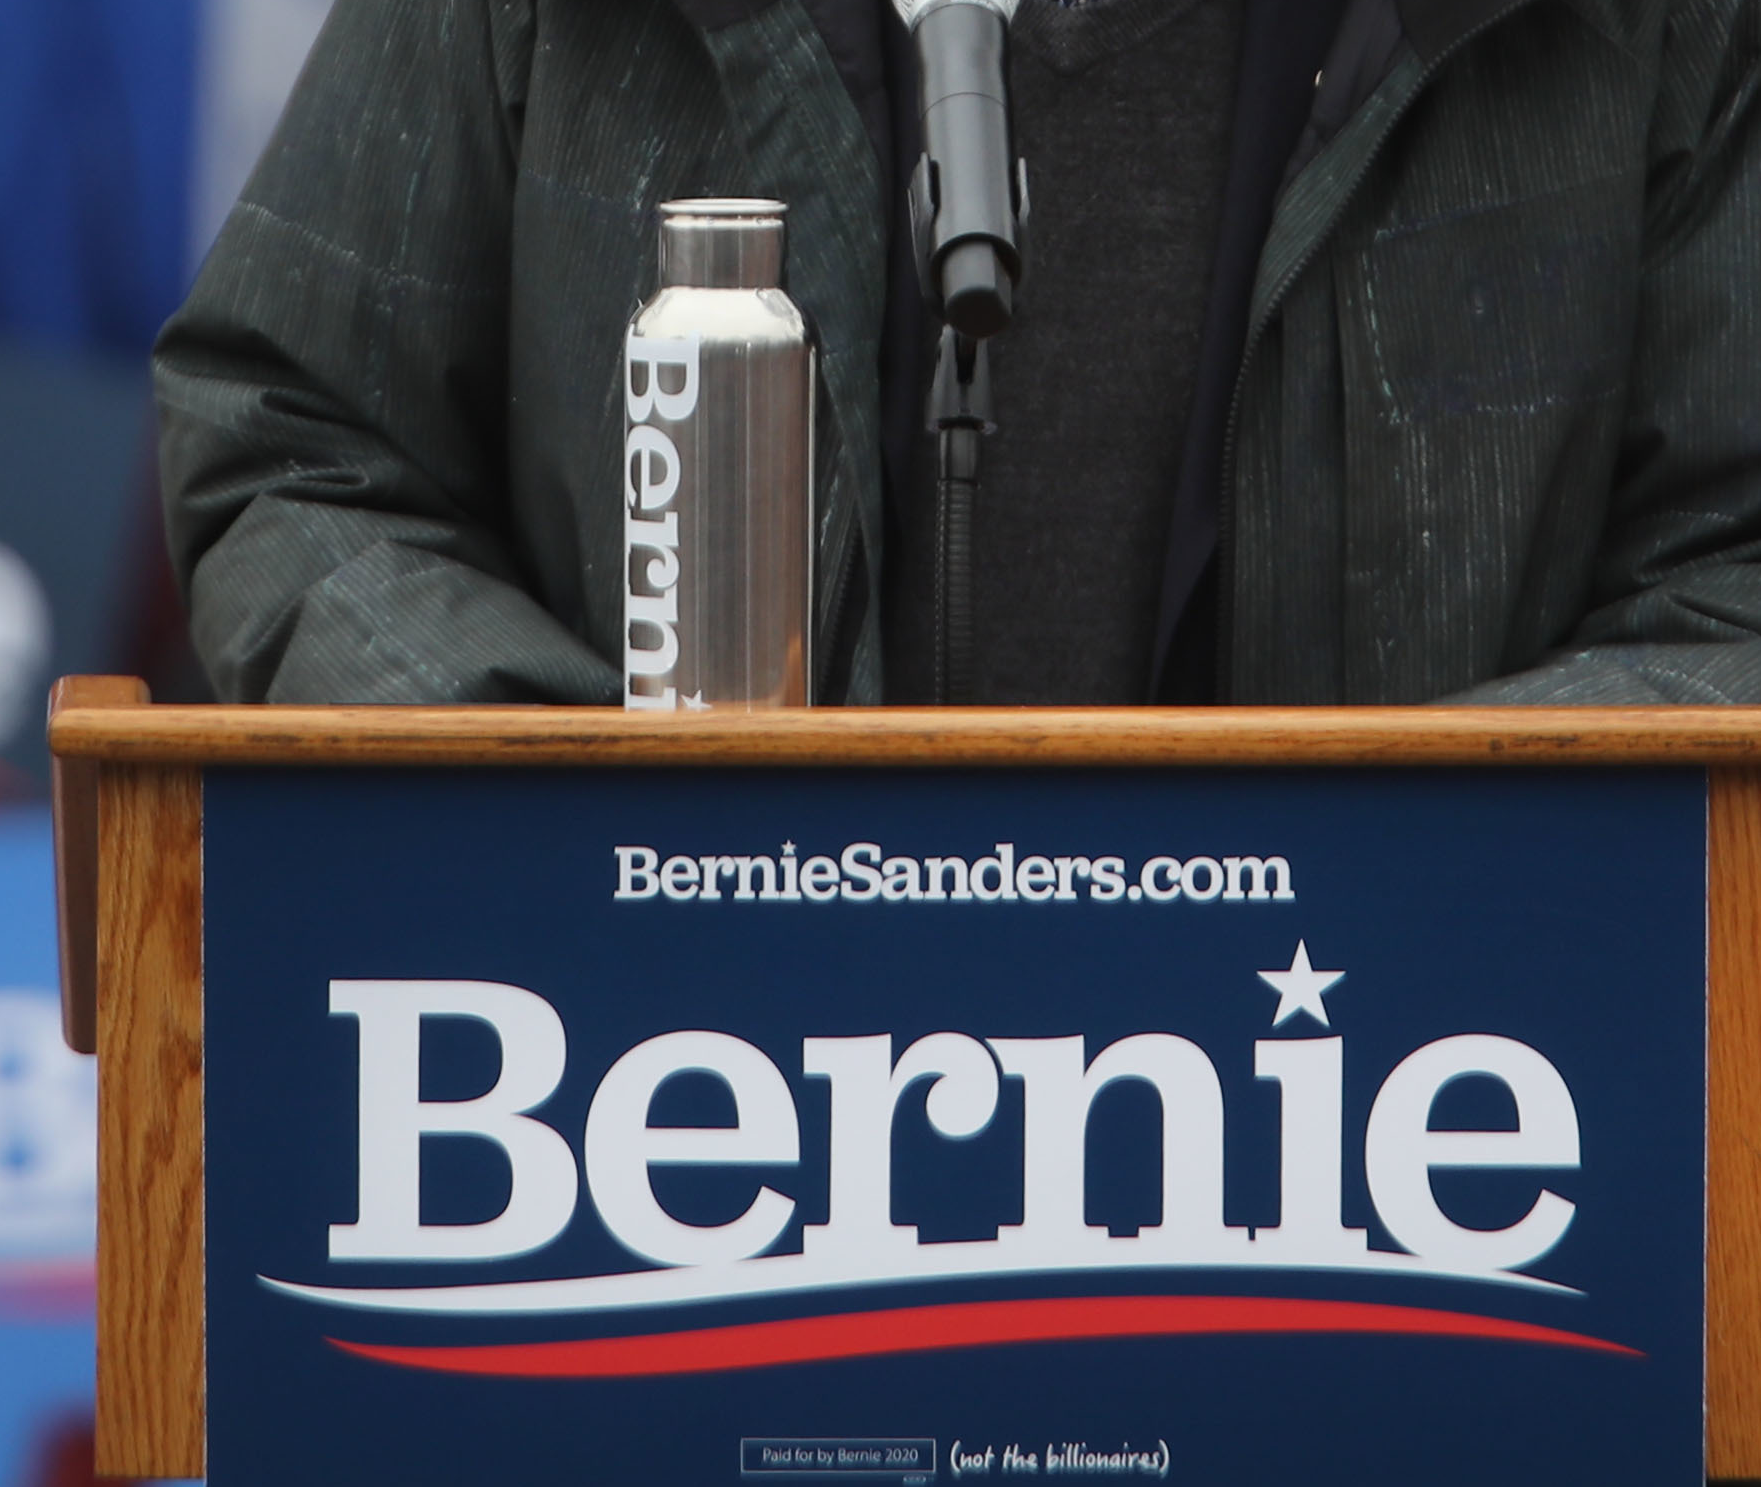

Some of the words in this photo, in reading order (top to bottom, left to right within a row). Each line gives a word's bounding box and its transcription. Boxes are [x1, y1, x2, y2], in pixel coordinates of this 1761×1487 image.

[613, 840, 1295, 902] BernieSanders.com
[330, 940, 1581, 1267] Bernie
[763, 1447, 791, 1462] Paid
[795, 1447, 814, 1462] for
[817, 1447, 834, 1465] by
[838, 1447, 882, 1462] Bernie
[886, 1447, 919, 1462] 2020
[950, 1439, 995, 1472] (not
[1002, 1442, 1037, 1469] the
[1046, 1439, 1170, 1474] billionaires)
